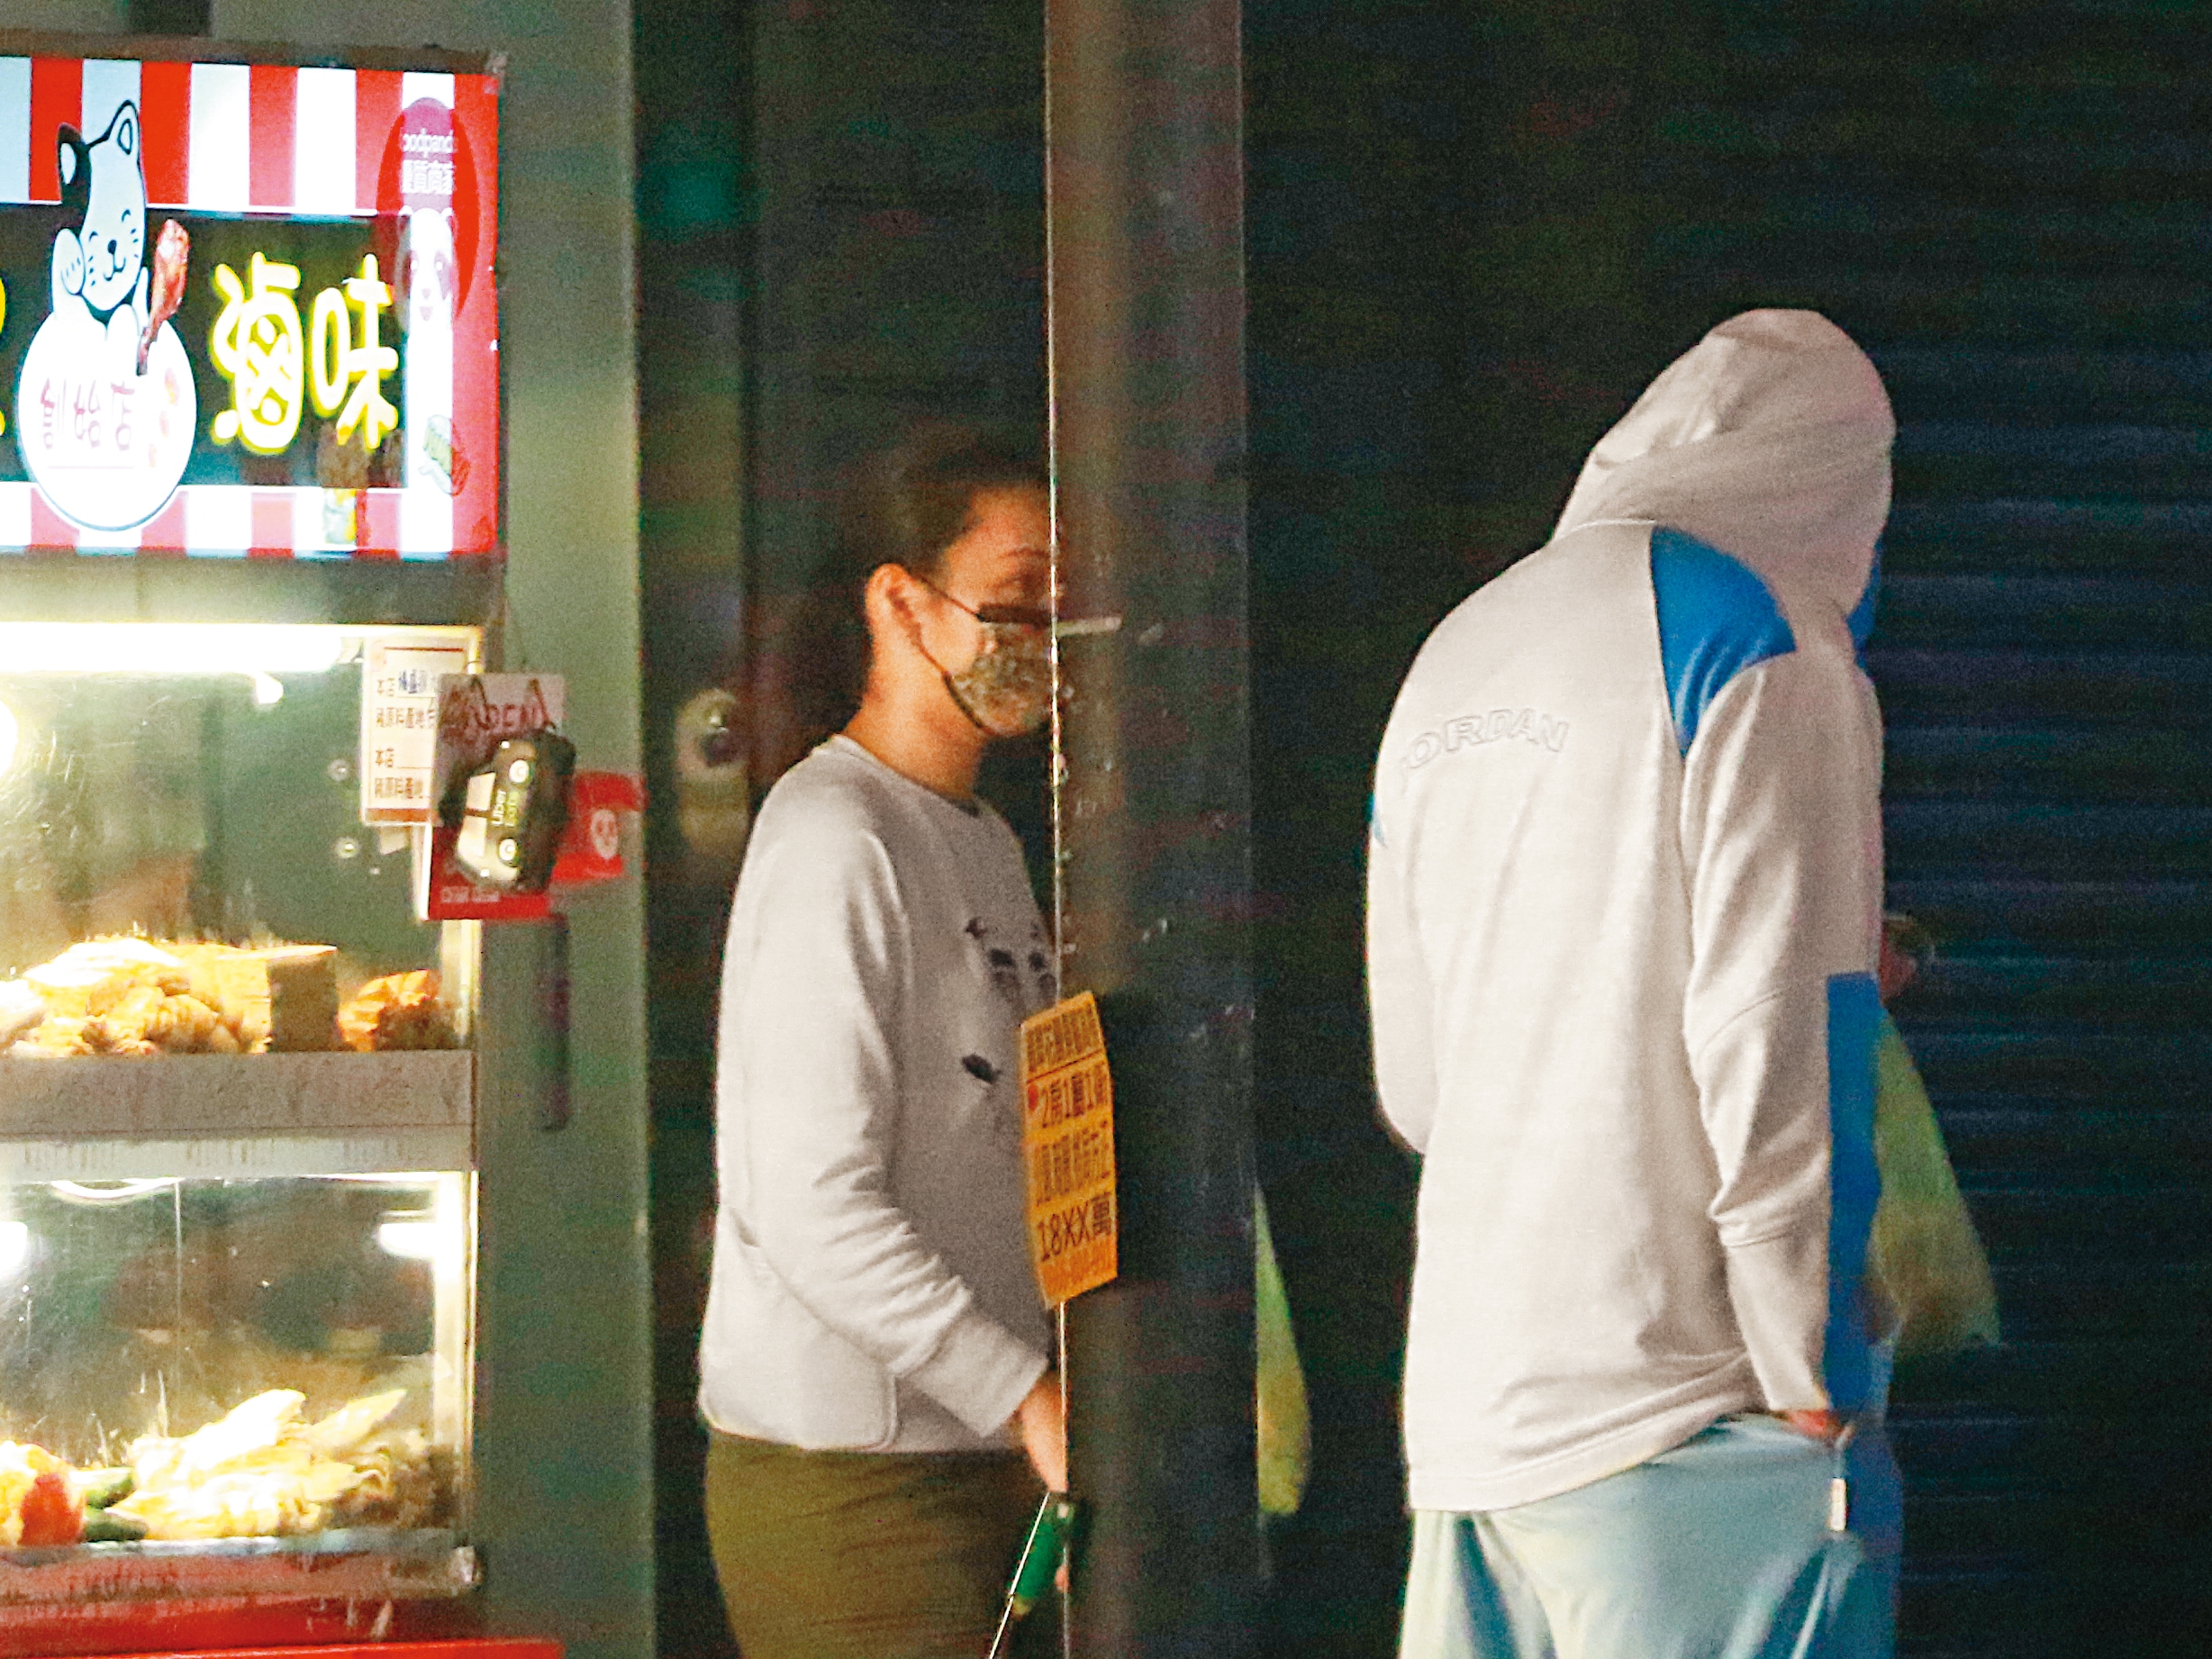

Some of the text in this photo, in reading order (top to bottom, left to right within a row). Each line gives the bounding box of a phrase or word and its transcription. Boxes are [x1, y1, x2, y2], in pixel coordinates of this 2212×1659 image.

[40, 376, 136, 451] 創始店
[211, 252, 400, 453] 滷味
